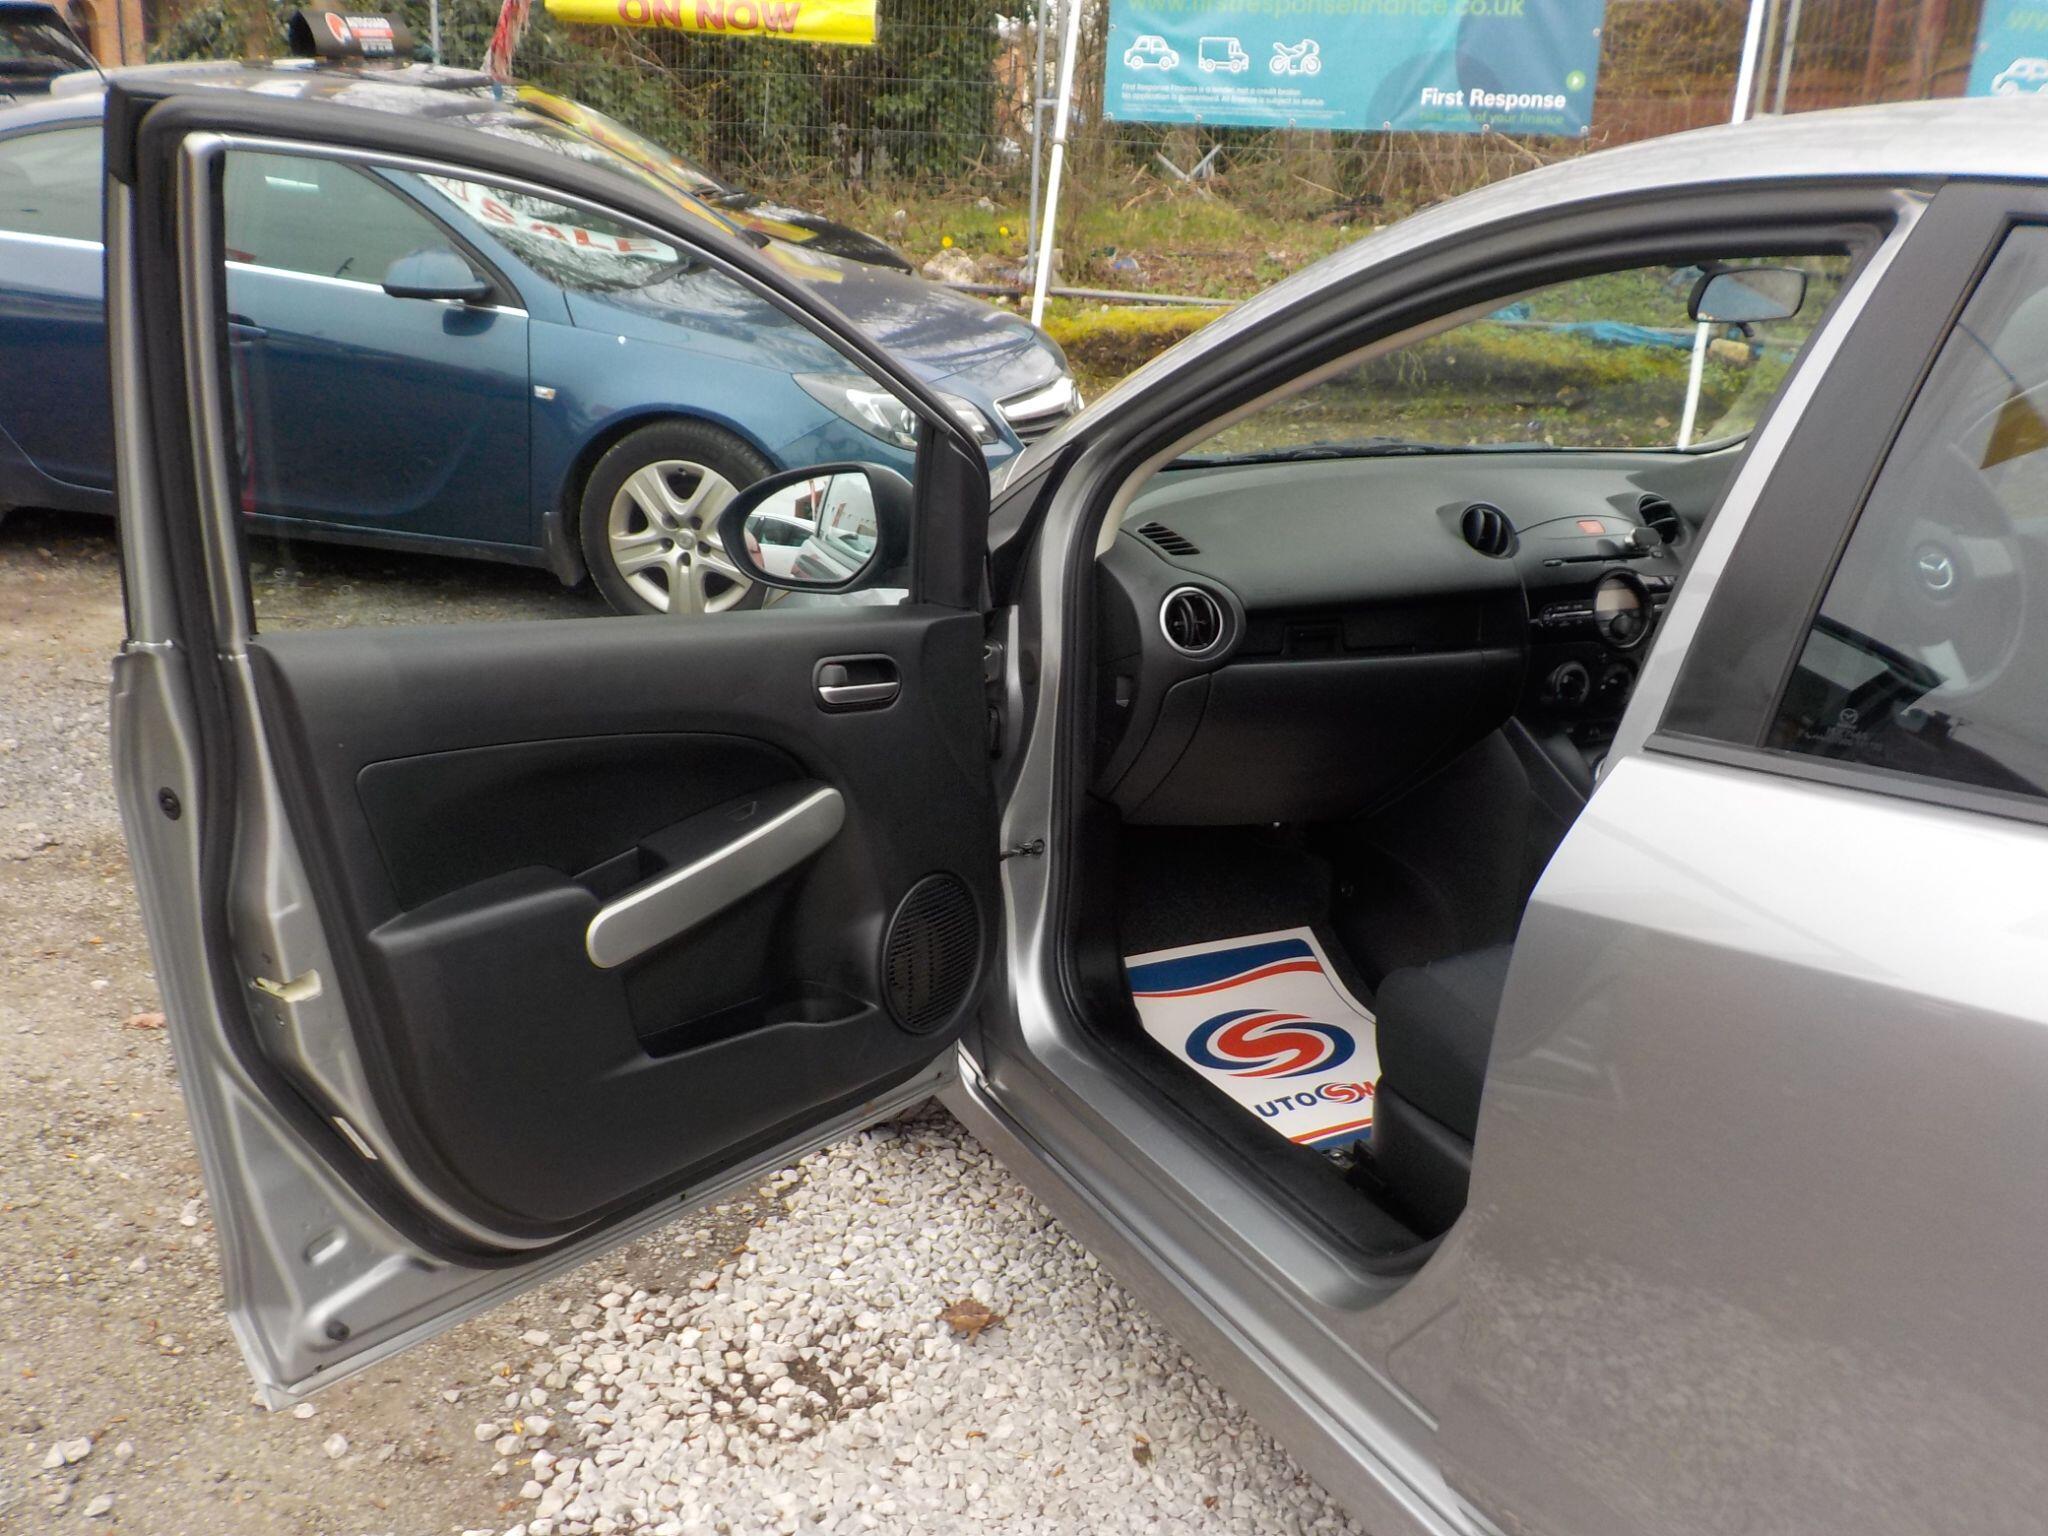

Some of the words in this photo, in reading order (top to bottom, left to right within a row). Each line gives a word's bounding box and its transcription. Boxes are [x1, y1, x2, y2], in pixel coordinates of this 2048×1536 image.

[618, 0, 683, 28] ON
[695, 0, 802, 33] NOW
[1420, 87, 1464, 106] First
[1469, 88, 1566, 111] Response
[1474, 110, 1488, 123] of
[1490, 112, 1516, 125] your
[1519, 112, 1565, 125] finance
